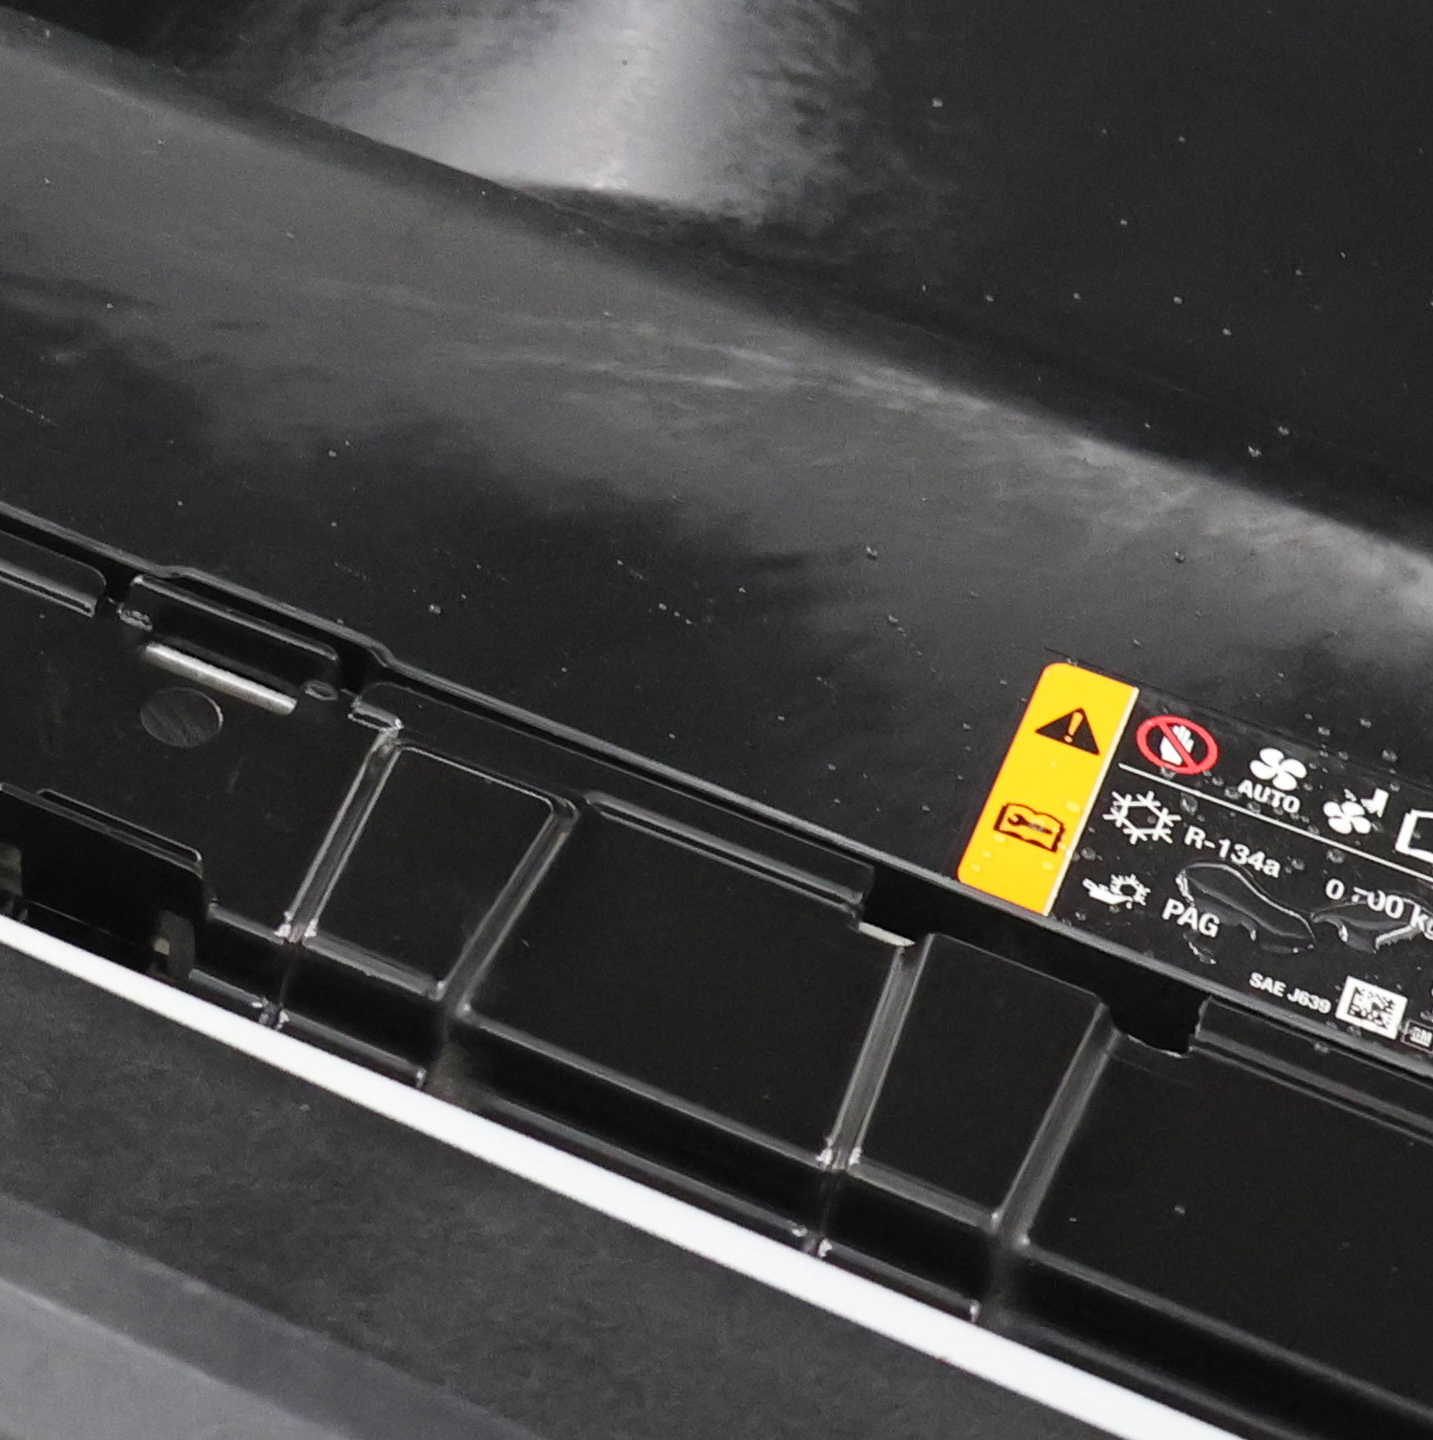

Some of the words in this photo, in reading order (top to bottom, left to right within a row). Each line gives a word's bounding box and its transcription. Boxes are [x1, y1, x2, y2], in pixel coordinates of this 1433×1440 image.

[1237, 779, 1300, 813] AUTO
[1184, 825, 1281, 877] R-134a
[1325, 878, 1404, 919] 0700
[1162, 898, 1220, 938] PAG
[1249, 972, 1287, 997] SAE
[1286, 987, 1332, 1014] J639
